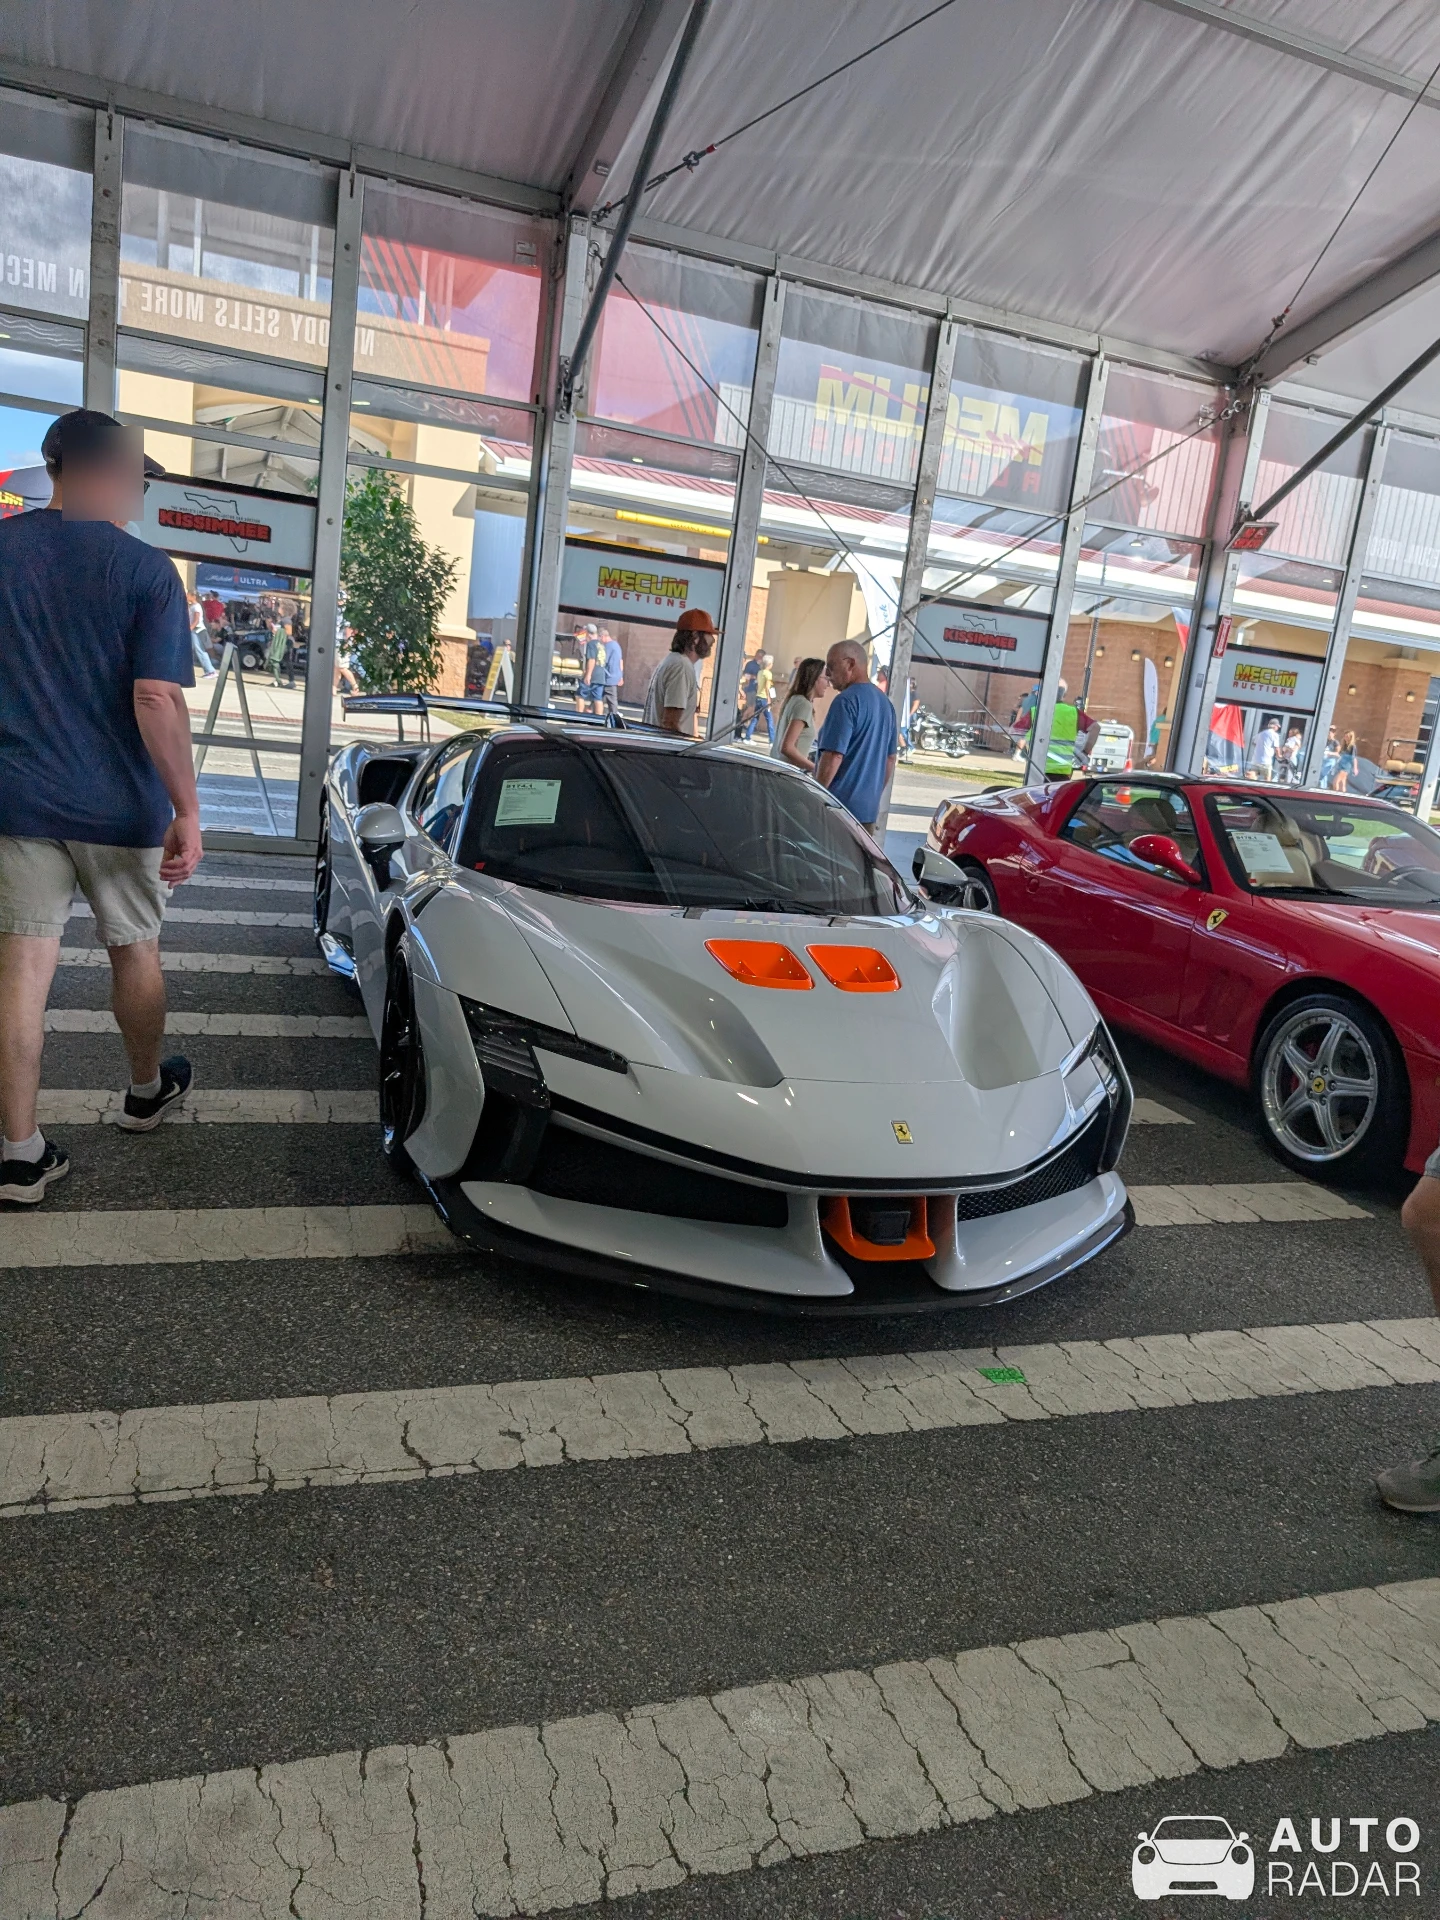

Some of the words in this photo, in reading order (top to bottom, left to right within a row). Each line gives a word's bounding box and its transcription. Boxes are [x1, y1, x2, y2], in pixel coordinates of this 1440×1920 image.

[159, 508, 271, 543] KISSIMMEE
[239, 577, 268, 587] ULTRA
[598, 566, 690, 600] MECUM
[597, 587, 687, 609] AUCTIONS
[943, 627, 1017, 651] KISSIMMEE
[1232, 680, 1295, 696] AUCTIONS
[1234, 663, 1298, 689] MECUM
